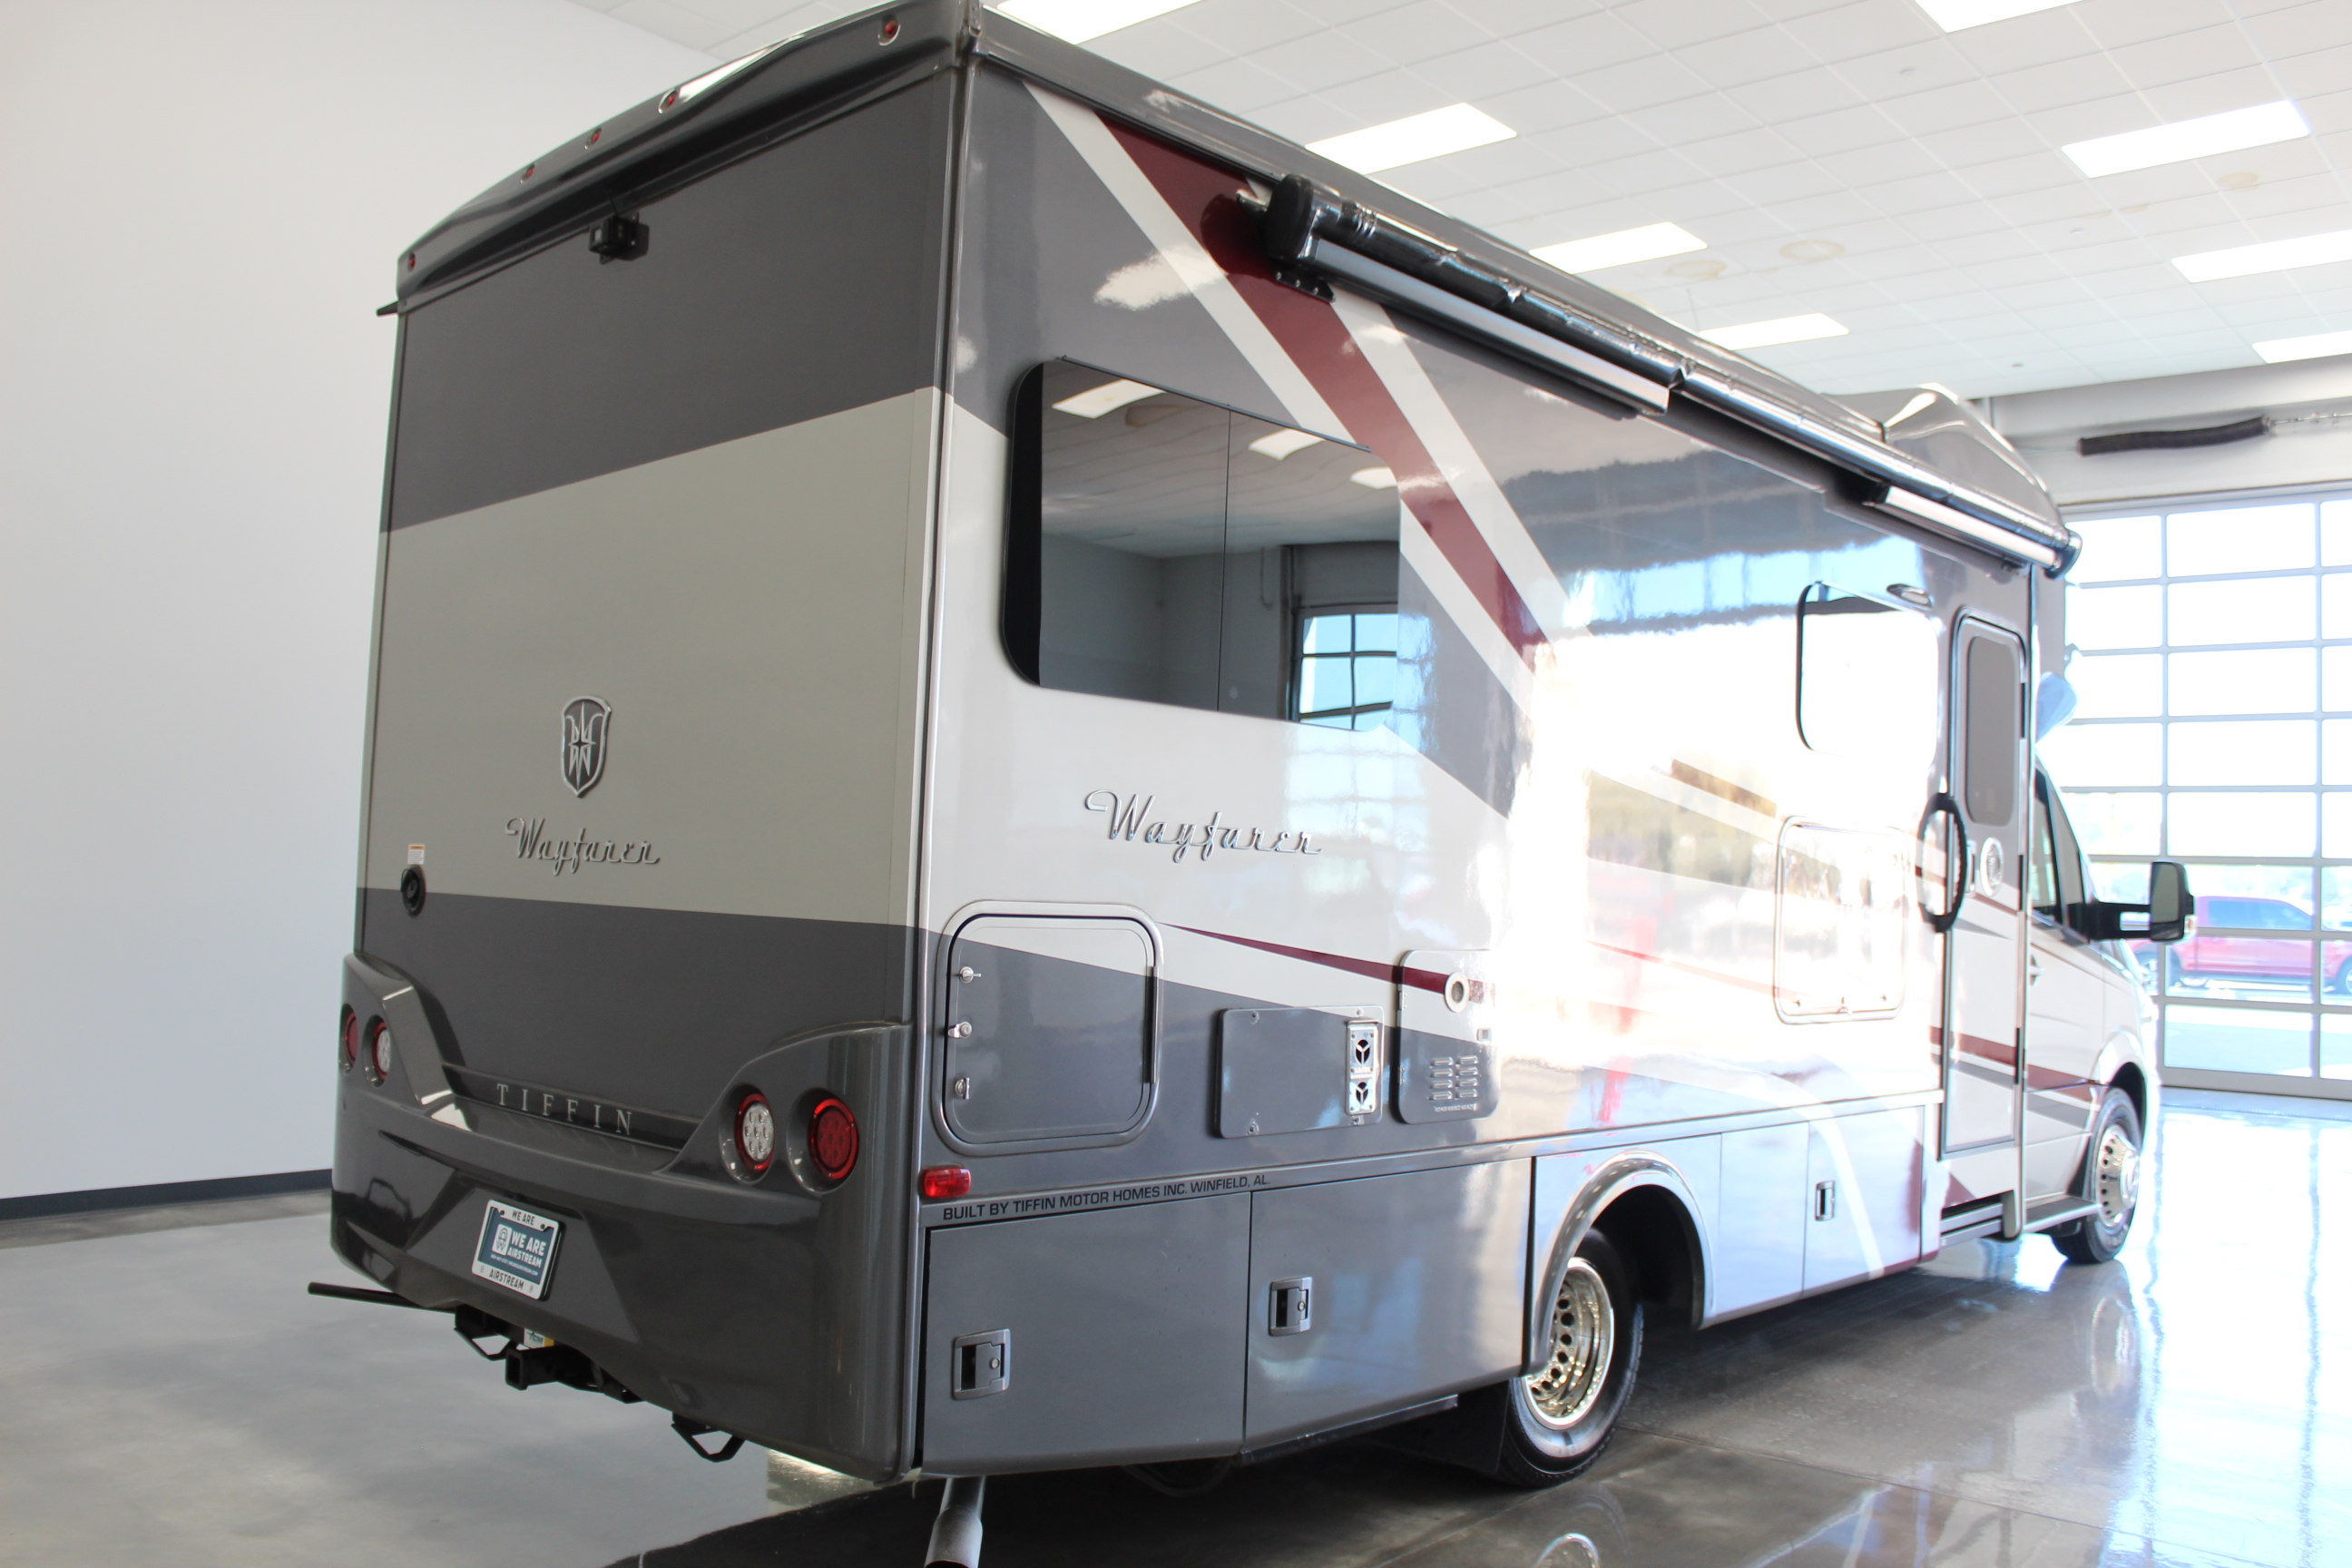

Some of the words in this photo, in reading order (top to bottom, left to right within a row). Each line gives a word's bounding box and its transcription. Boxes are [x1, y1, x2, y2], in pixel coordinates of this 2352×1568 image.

[1084, 789, 1323, 863] Wayfarer
[505, 818, 661, 877] Wayfarer
[496, 1083, 632, 1135] TIFFIN
[943, 1204, 985, 1220] BUILT
[989, 1201, 1009, 1216] BY
[1013, 1197, 1055, 1213] TIFFIN
[1059, 1191, 1109, 1208] MOTOR
[1112, 1186, 1161, 1202] HOMES
[1163, 1183, 1188, 1197] INC.
[1190, 1176, 1250, 1193] WINFIELD,
[1253, 1174, 1270, 1186] AL.
[512, 1210, 522, 1221] WE
[522, 1213, 535, 1226] ARE
[506, 1247, 543, 1269] AIRSTREAM
[511, 1230, 527, 1249] WE
[525, 1237, 546, 1257] ARE
[488, 1269, 524, 1290] AIRSTREAM
